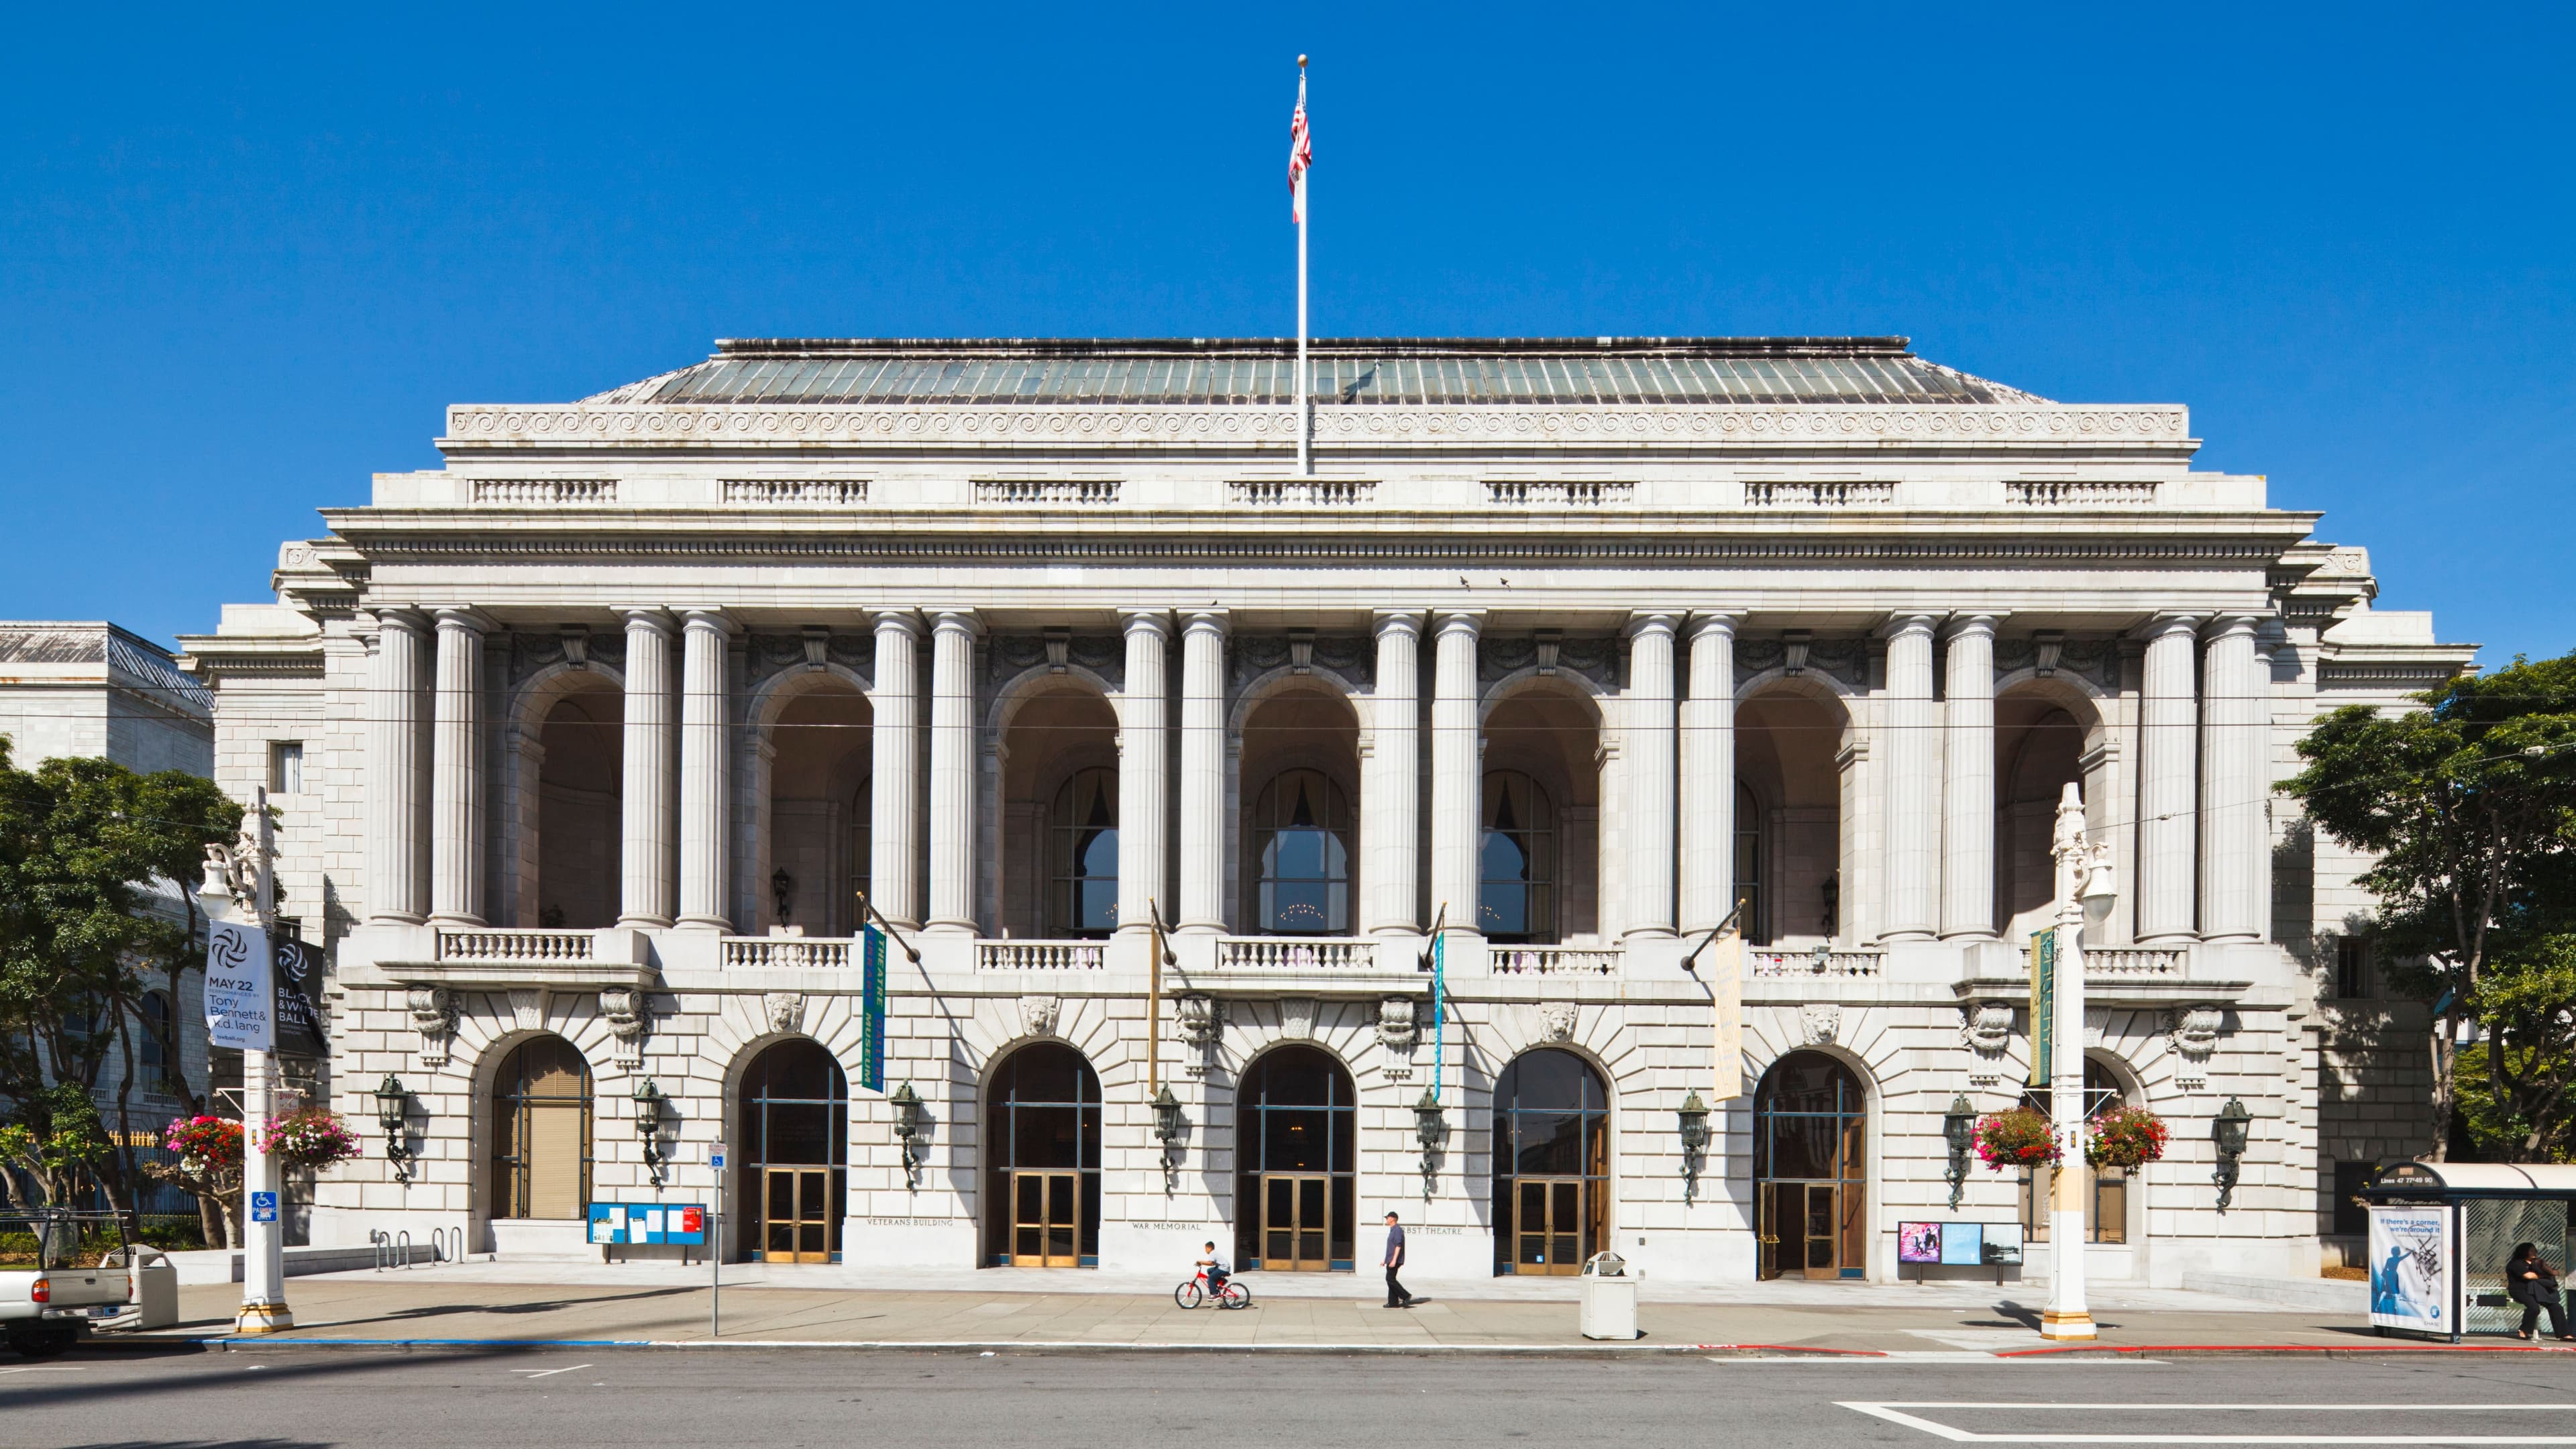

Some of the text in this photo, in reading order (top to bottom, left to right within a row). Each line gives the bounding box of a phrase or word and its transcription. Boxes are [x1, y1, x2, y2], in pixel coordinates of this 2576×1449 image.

[865, 930, 874, 1000] LIBRARY
[876, 939, 885, 1007] THEATRE
[209, 977, 254, 991] MAY 22
[209, 988, 252, 998] PERFORMANCES
[209, 994, 239, 1008] Tony
[278, 987, 312, 1005] BLCK
[279, 1012, 308, 1024] BALL
[286, 1000, 319, 1019] WTE
[213, 1017, 260, 1034] k.d. lang
[864, 1012, 872, 1084] MUSEUM
[875, 1019, 883, 1085] GALLERY
